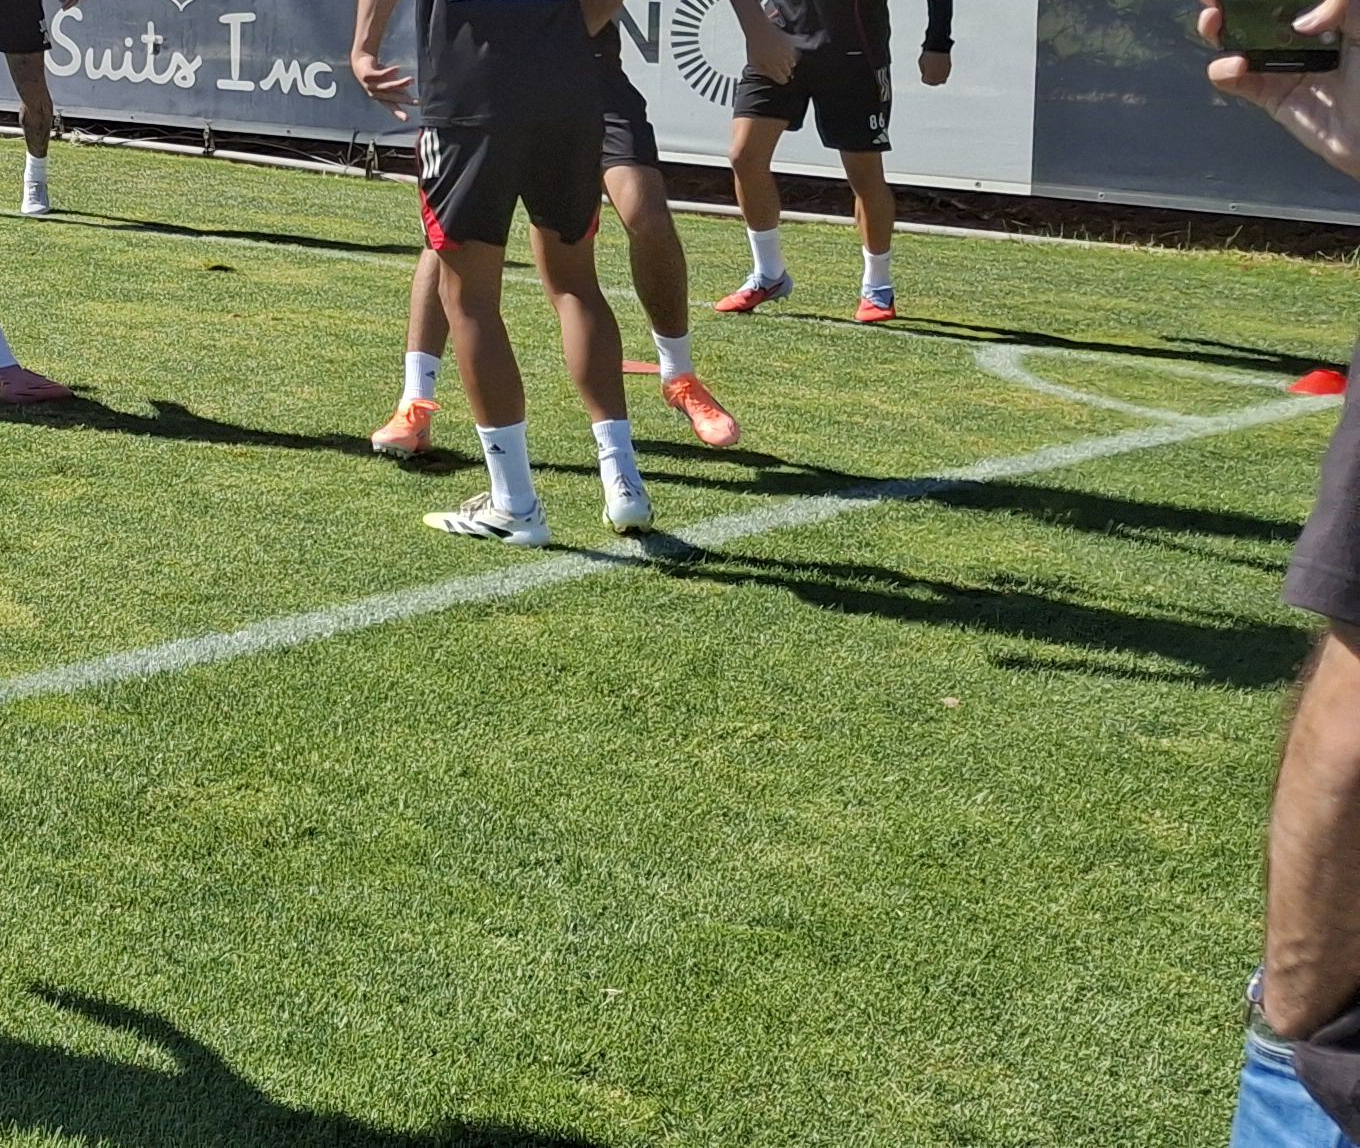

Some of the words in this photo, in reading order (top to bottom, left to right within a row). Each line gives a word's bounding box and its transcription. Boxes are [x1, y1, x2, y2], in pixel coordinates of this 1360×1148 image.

[44, 6, 203, 89] Suits
[216, 12, 337, 98] Inc
[869, 112, 885, 130] 86
